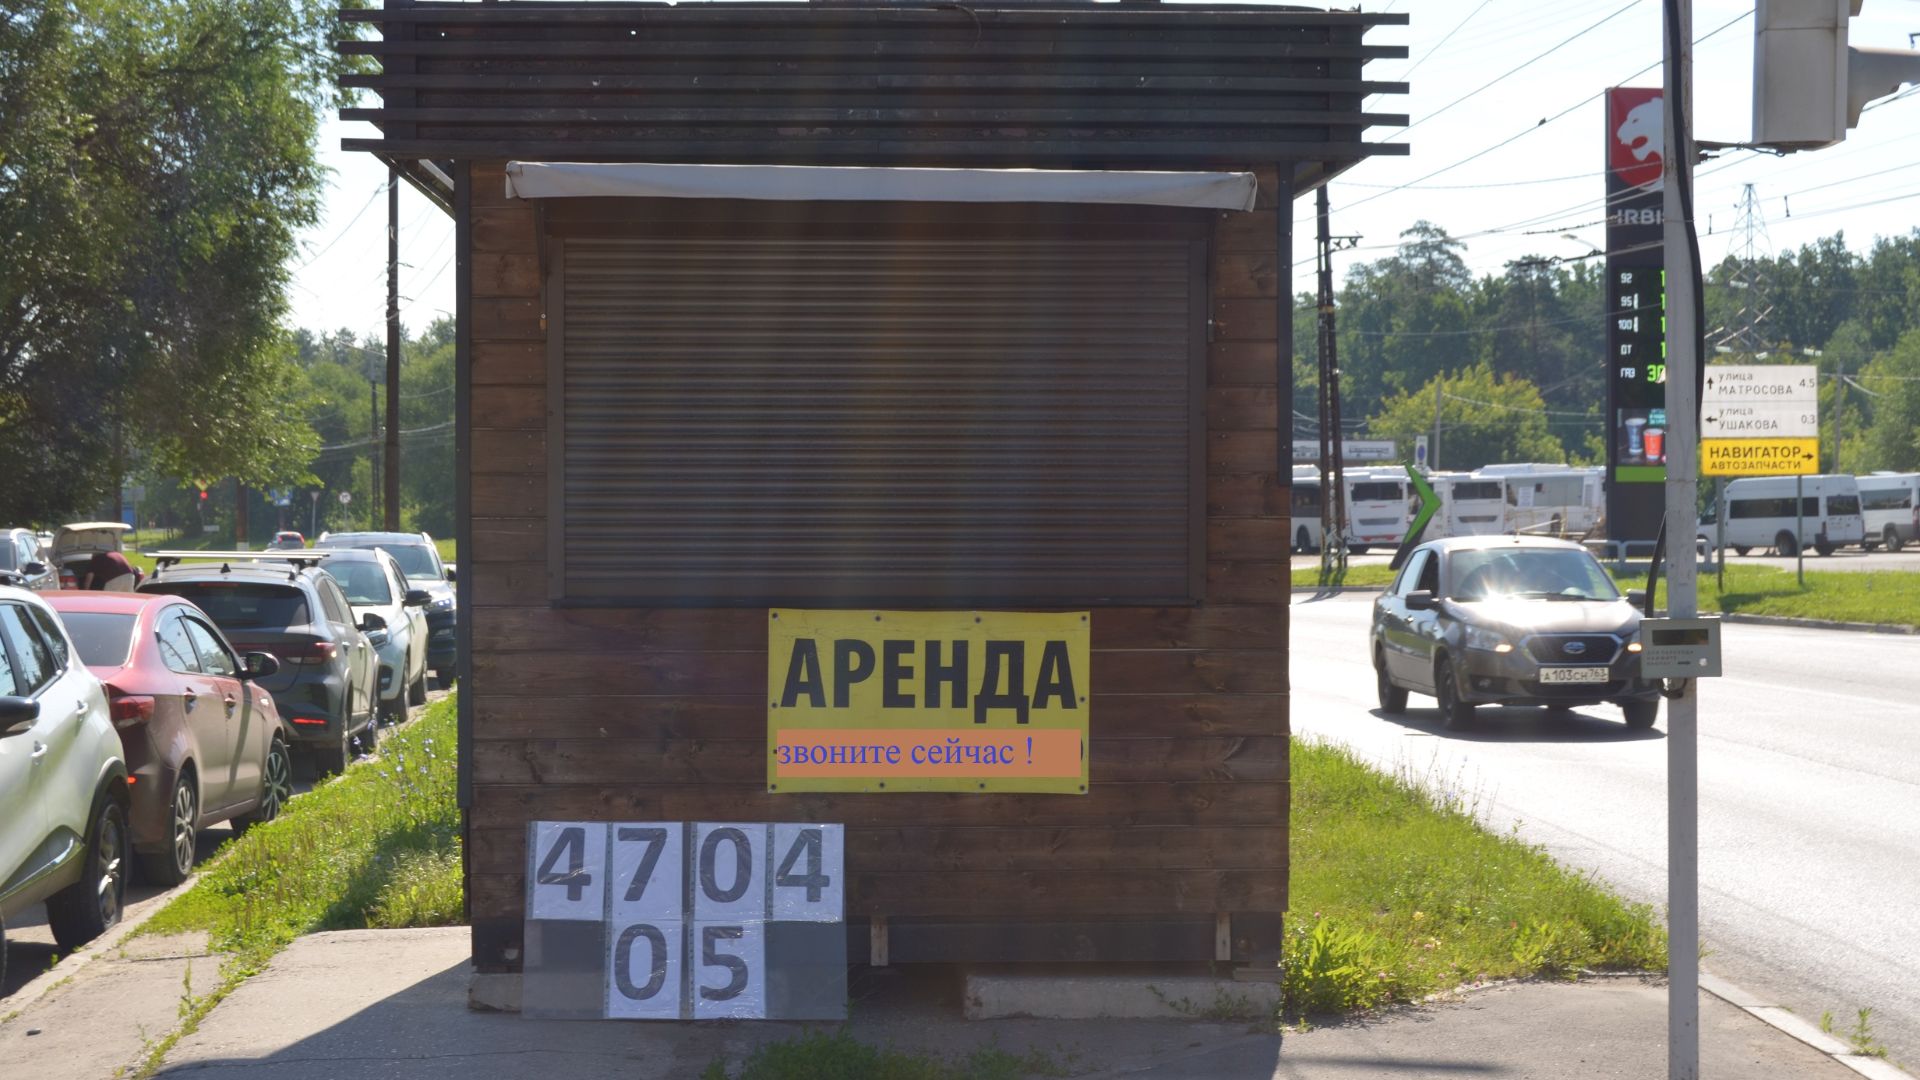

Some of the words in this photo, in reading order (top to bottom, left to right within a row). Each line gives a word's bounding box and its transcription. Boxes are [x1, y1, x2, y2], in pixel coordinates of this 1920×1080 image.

[1617, 208, 1665, 225] IRBI
[1620, 272, 1633, 285] 92
[1620, 295, 1633, 308] 95
[1618, 319, 1633, 331] 100
[1719, 373, 1753, 382] улица
[1718, 385, 1793, 395] МАТРОСОВА
[1719, 408, 1753, 417] улица
[1719, 420, 1778, 430] УШАКОВА
[1710, 446, 1801, 459] НАВИГАТОР
[1710, 461, 1801, 470] АВТОЗАПЧАСТИ
[780, 638, 1077, 724] АРЕНДА
